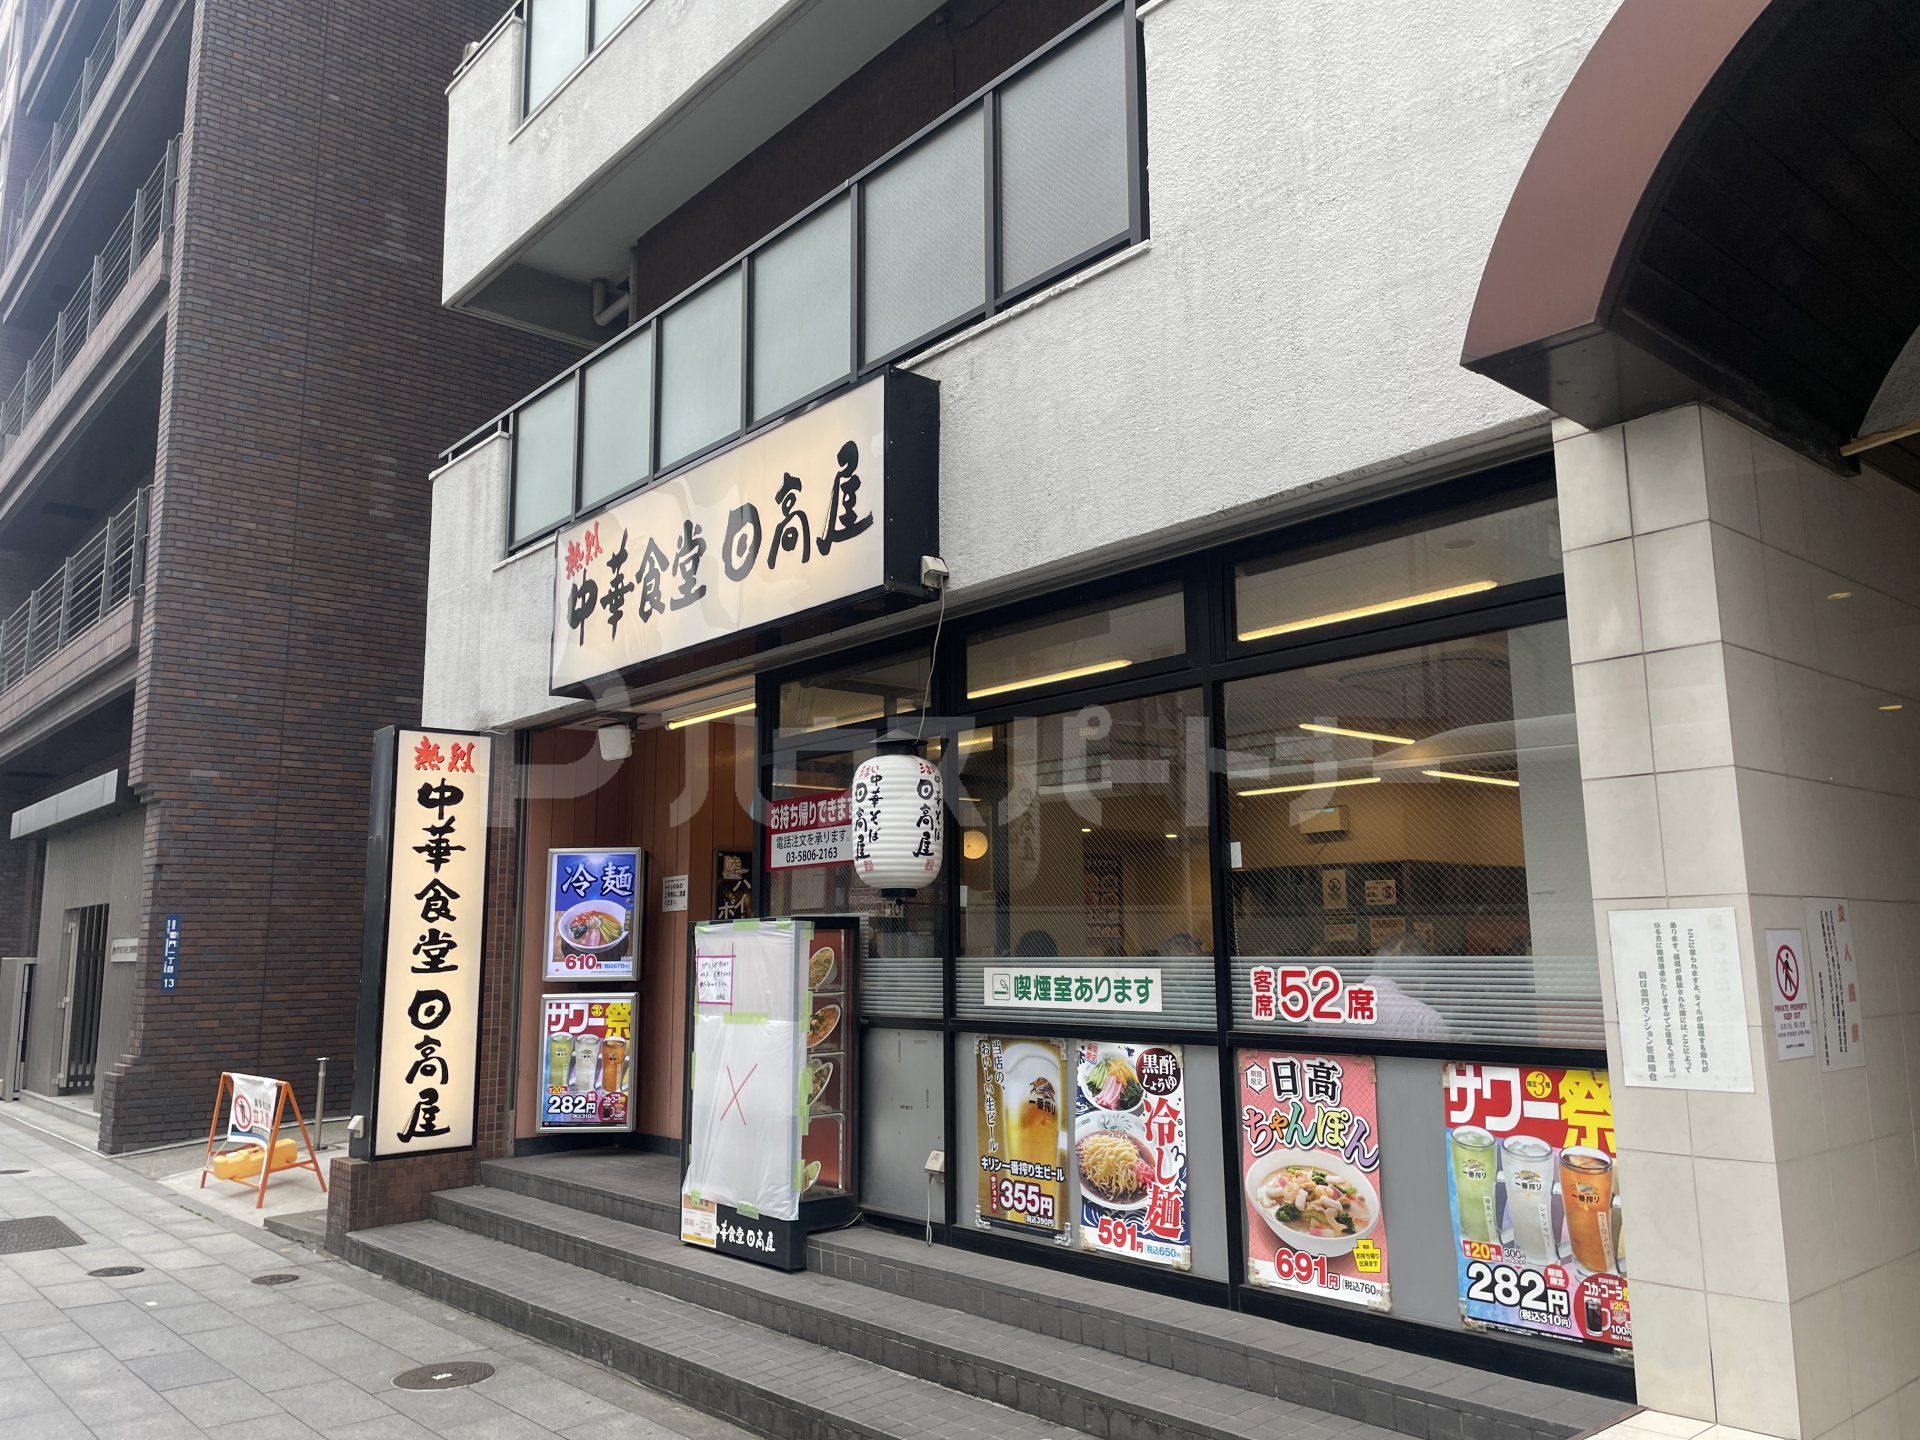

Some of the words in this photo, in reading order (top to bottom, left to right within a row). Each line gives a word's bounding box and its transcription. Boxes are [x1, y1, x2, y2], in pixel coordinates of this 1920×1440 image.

[565, 520, 603, 580] 熱烈
[567, 518, 708, 647] 中華食堂
[721, 439, 875, 583] 日高屋
[413, 735, 476, 773] 熱烈
[854, 781, 871, 862] 日高屋
[868, 773, 884, 844] 中華そば
[911, 778, 935, 858] 日高屋
[776, 829, 851, 850] 電話注文を承ります。
[785, 846, 839, 864] 03-5806-2163
[409, 777, 467, 974] 中華食堂
[562, 861, 634, 898] 冷麺
[565, 954, 602, 970] 610円
[163, 978, 175, 989] 13
[1014, 974, 1154, 1005] 喫煙室あります
[396, 988, 452, 1143] 日高屋
[1141, 1053, 1177, 1075] 黒酢
[1271, 1059, 1340, 1102] 日高
[981, 1041, 998, 1153] おいしい生ビール
[1142, 1074, 1178, 1093] しょうゆ
[547, 1094, 597, 1114] 282円
[1028, 1097, 1056, 1116] 一番搾り
[1449, 1063, 1617, 1154] サワー祭
[1242, 1101, 1380, 1168] ちゃんぽん
[981, 1156, 1065, 1182] キリン一番搾り生ビール
[1143, 1096, 1183, 1241] 冷し麺
[1001, 1180, 1053, 1217] 355円
[1098, 1217, 1144, 1253] 591円
[1275, 1248, 1340, 1291] 691円
[1468, 1260, 1570, 1315] 282円
[1519, 1309, 1572, 1329] (税込310円)
